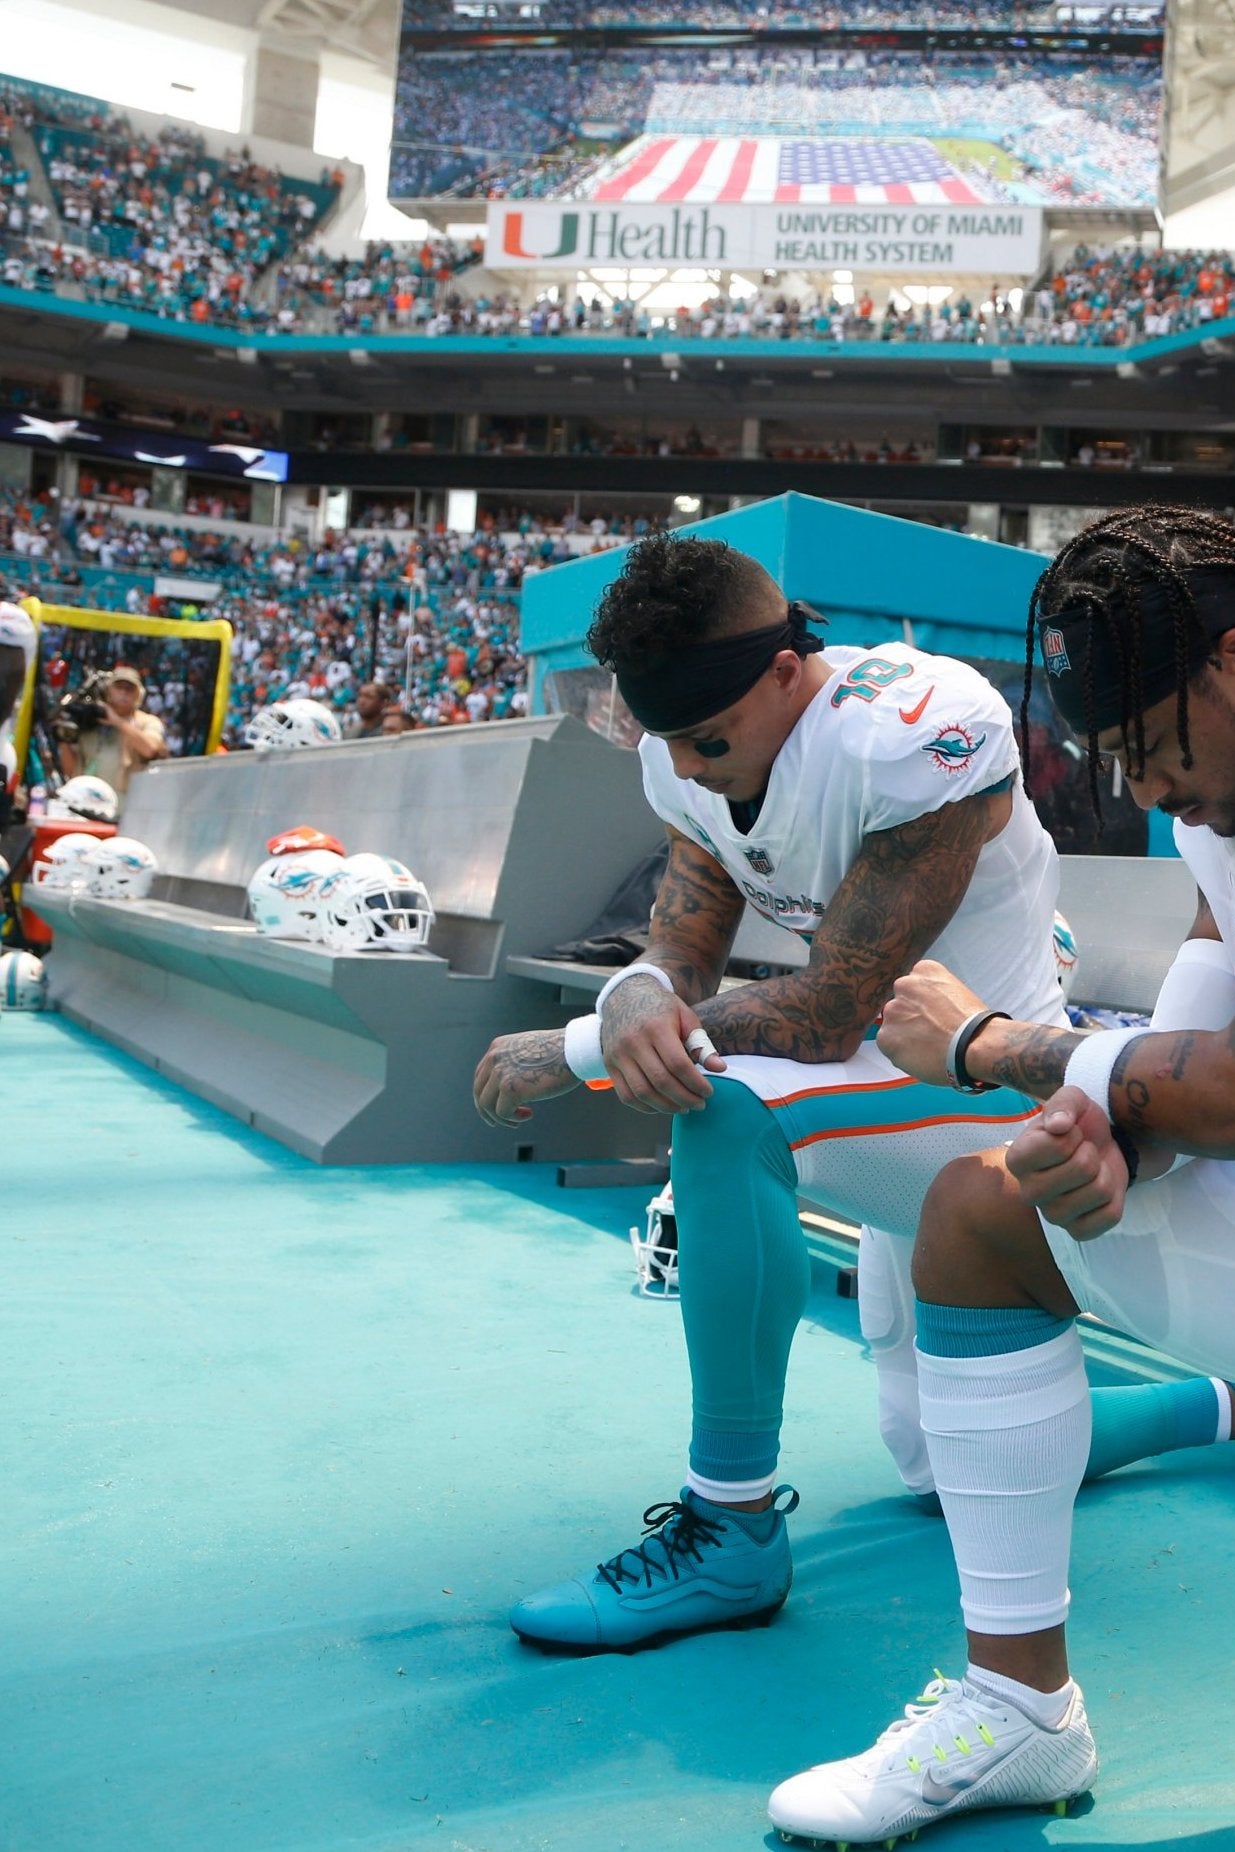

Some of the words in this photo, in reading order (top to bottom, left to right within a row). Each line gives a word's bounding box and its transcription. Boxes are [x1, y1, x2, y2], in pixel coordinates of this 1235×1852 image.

[776, 213, 907, 235] UNIVERSITY
[911, 213, 943, 236] OF
[949, 214, 1023, 236] MIAMI
[774, 241, 858, 262] HEALTH
[865, 242, 954, 263] SYSTEM
[831, 658, 914, 708] 10
